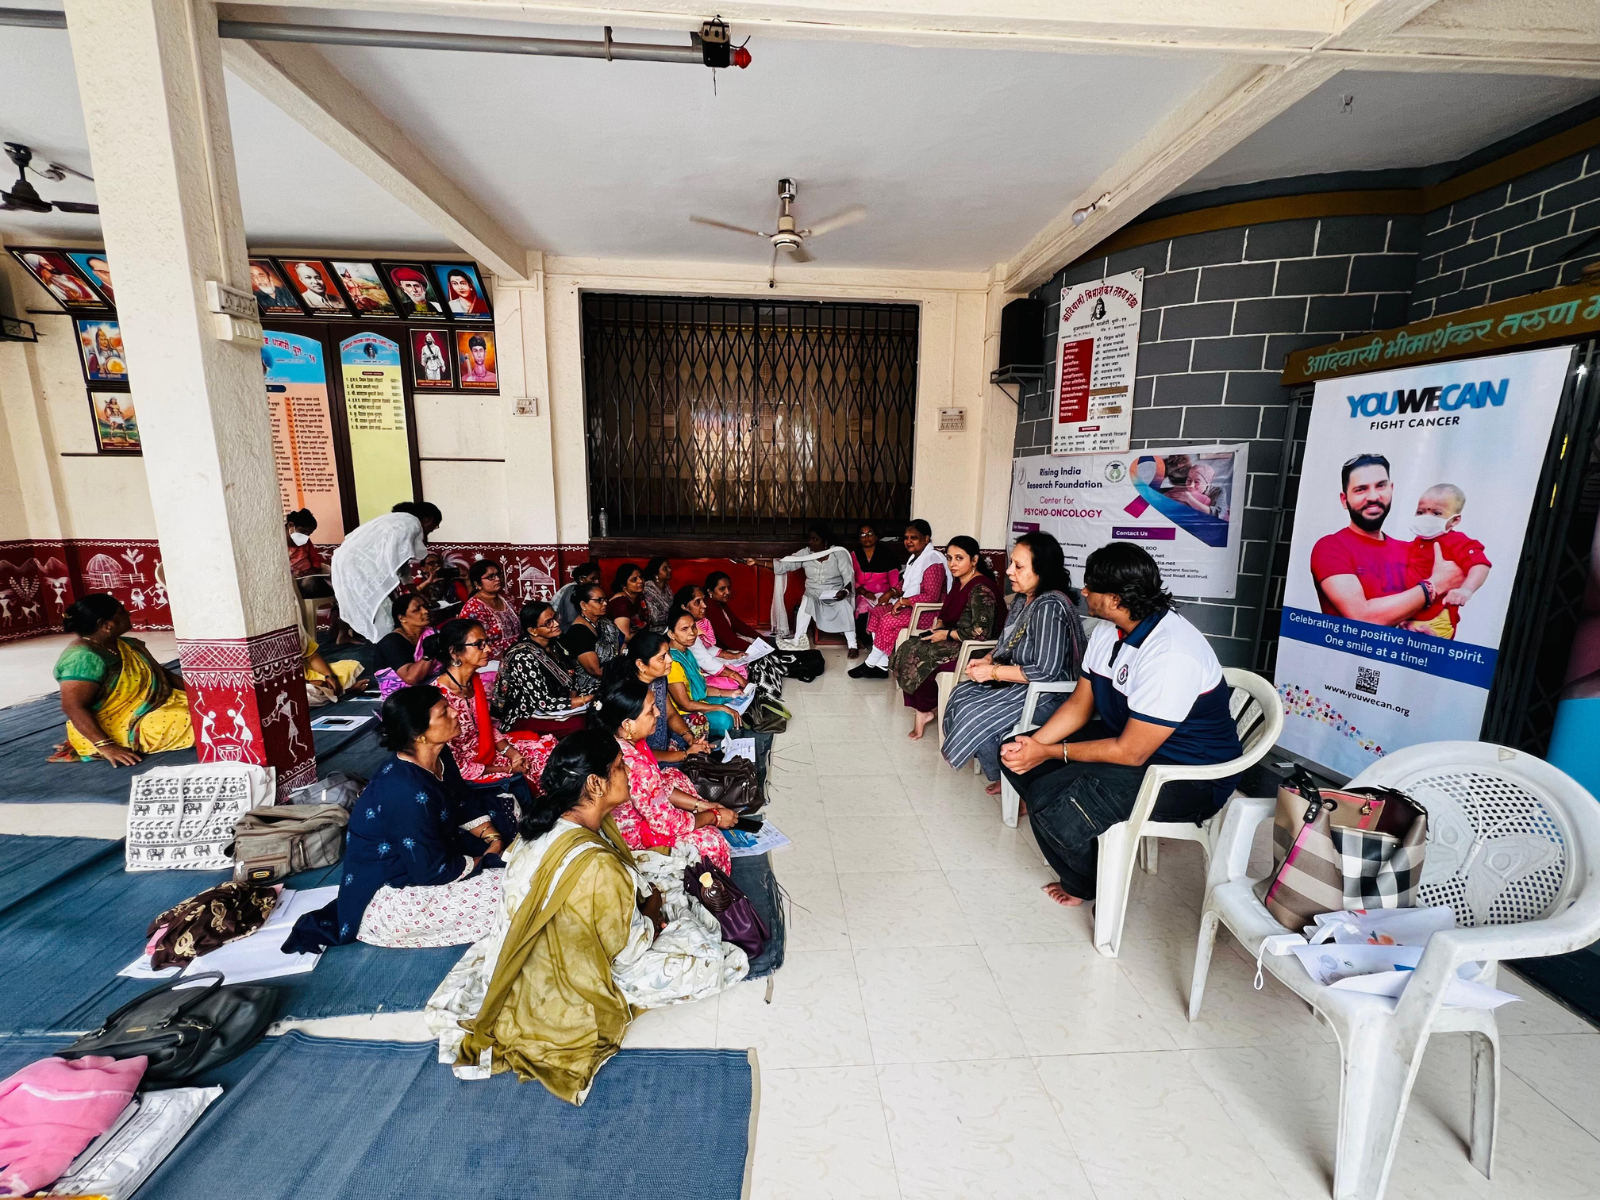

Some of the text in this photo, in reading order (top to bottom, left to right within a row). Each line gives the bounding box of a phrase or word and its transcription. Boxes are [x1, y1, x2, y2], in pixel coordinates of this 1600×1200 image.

[1303, 337, 1384, 376] आदिवासी
[1384, 322, 1494, 358] भीमाशंकर
[1497, 299, 1582, 338] तरुण
[1346, 378, 1509, 418] YOUWECAN
[1369, 416, 1461, 431] FIGHT CANCER
[1039, 466, 1082, 478] Rising India
[1027, 480, 1103, 489] Research Foundation
[1039, 495, 1075, 505] Center for
[1024, 508, 1103, 518] PSYCHO-ONCOLOGY
[1289, 612, 1485, 664] Celebrating the positive human spirit.
[1325, 634, 1428, 667] One smile at a time!
[1324, 684, 1410, 717] www.youwecan.org
